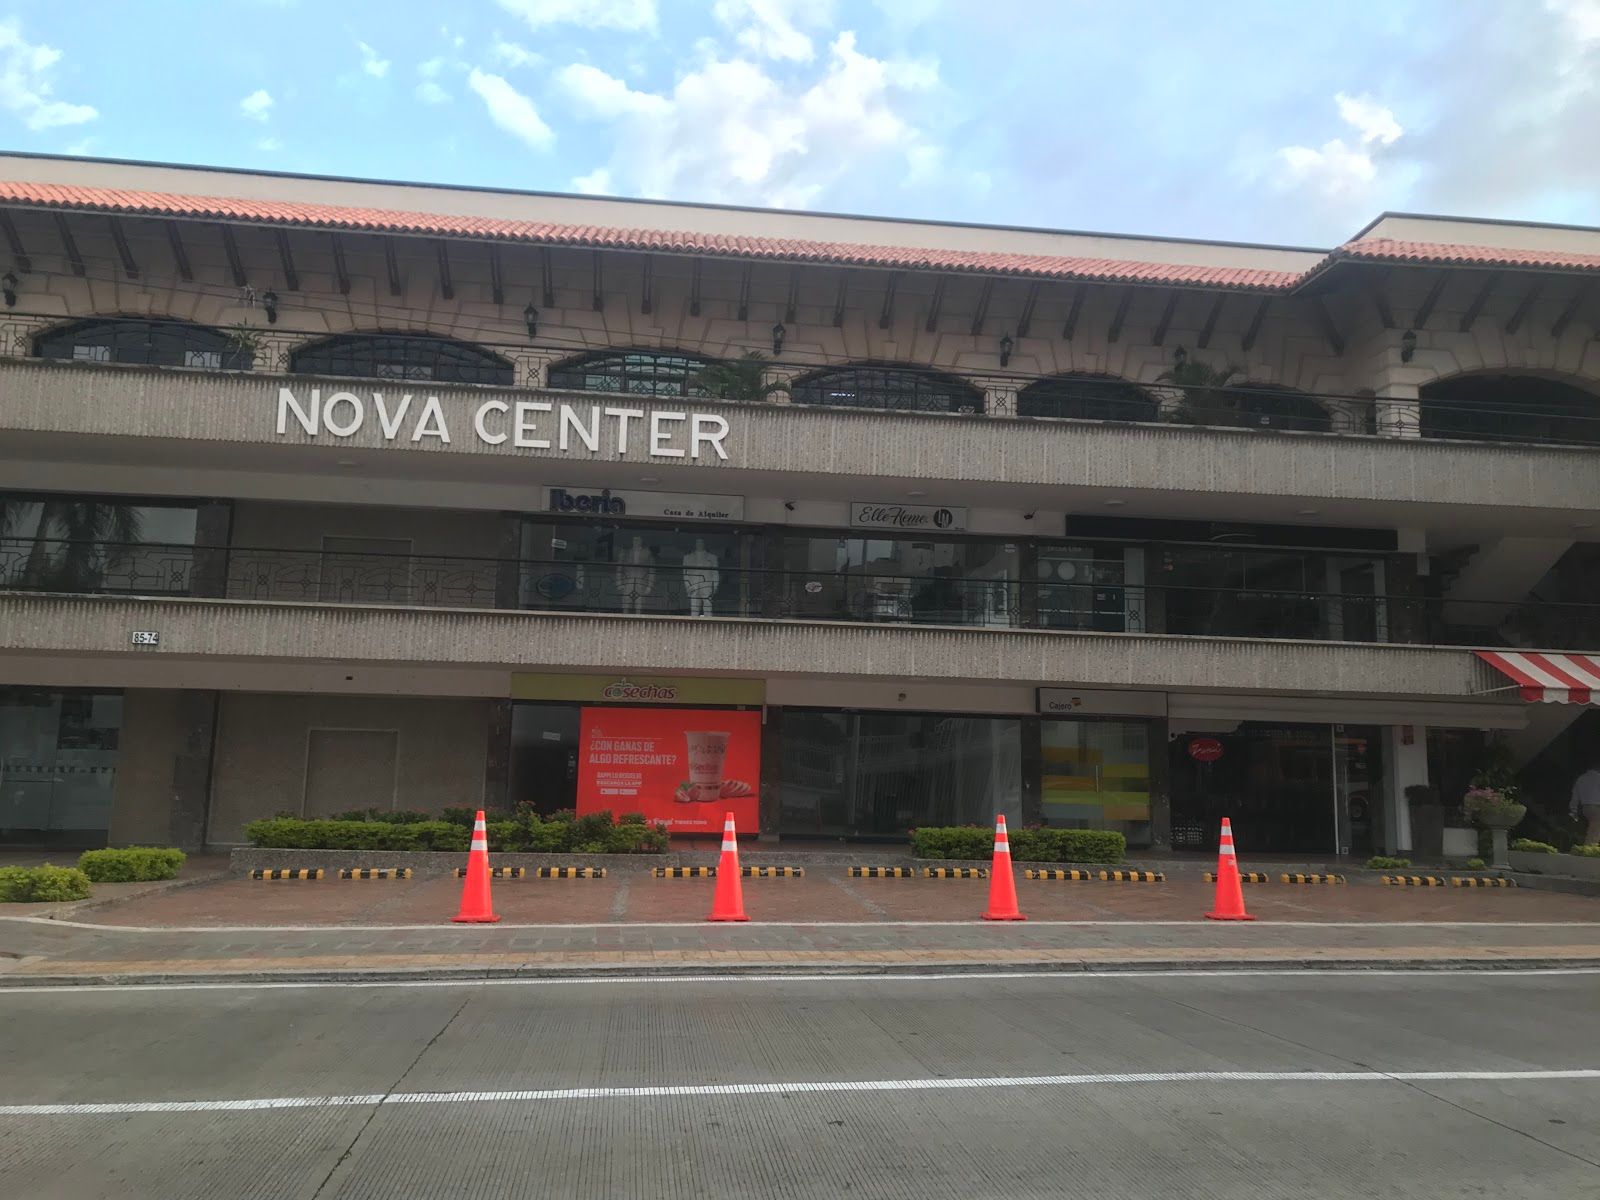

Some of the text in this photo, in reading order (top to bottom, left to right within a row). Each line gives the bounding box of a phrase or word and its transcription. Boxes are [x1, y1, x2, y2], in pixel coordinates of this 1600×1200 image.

[276, 388, 730, 460] NOVA CENTER
[663, 508, 729, 519] Casa de Alquiler
[859, 506, 888, 523] Elle
[134, 632, 159, 643] 85-74
[1049, 701, 1072, 711] Cajero
[614, 741, 642, 752] GANAS
[643, 742, 655, 752] DE
[589, 753, 677, 765] ALGO REFRESCANTE?
